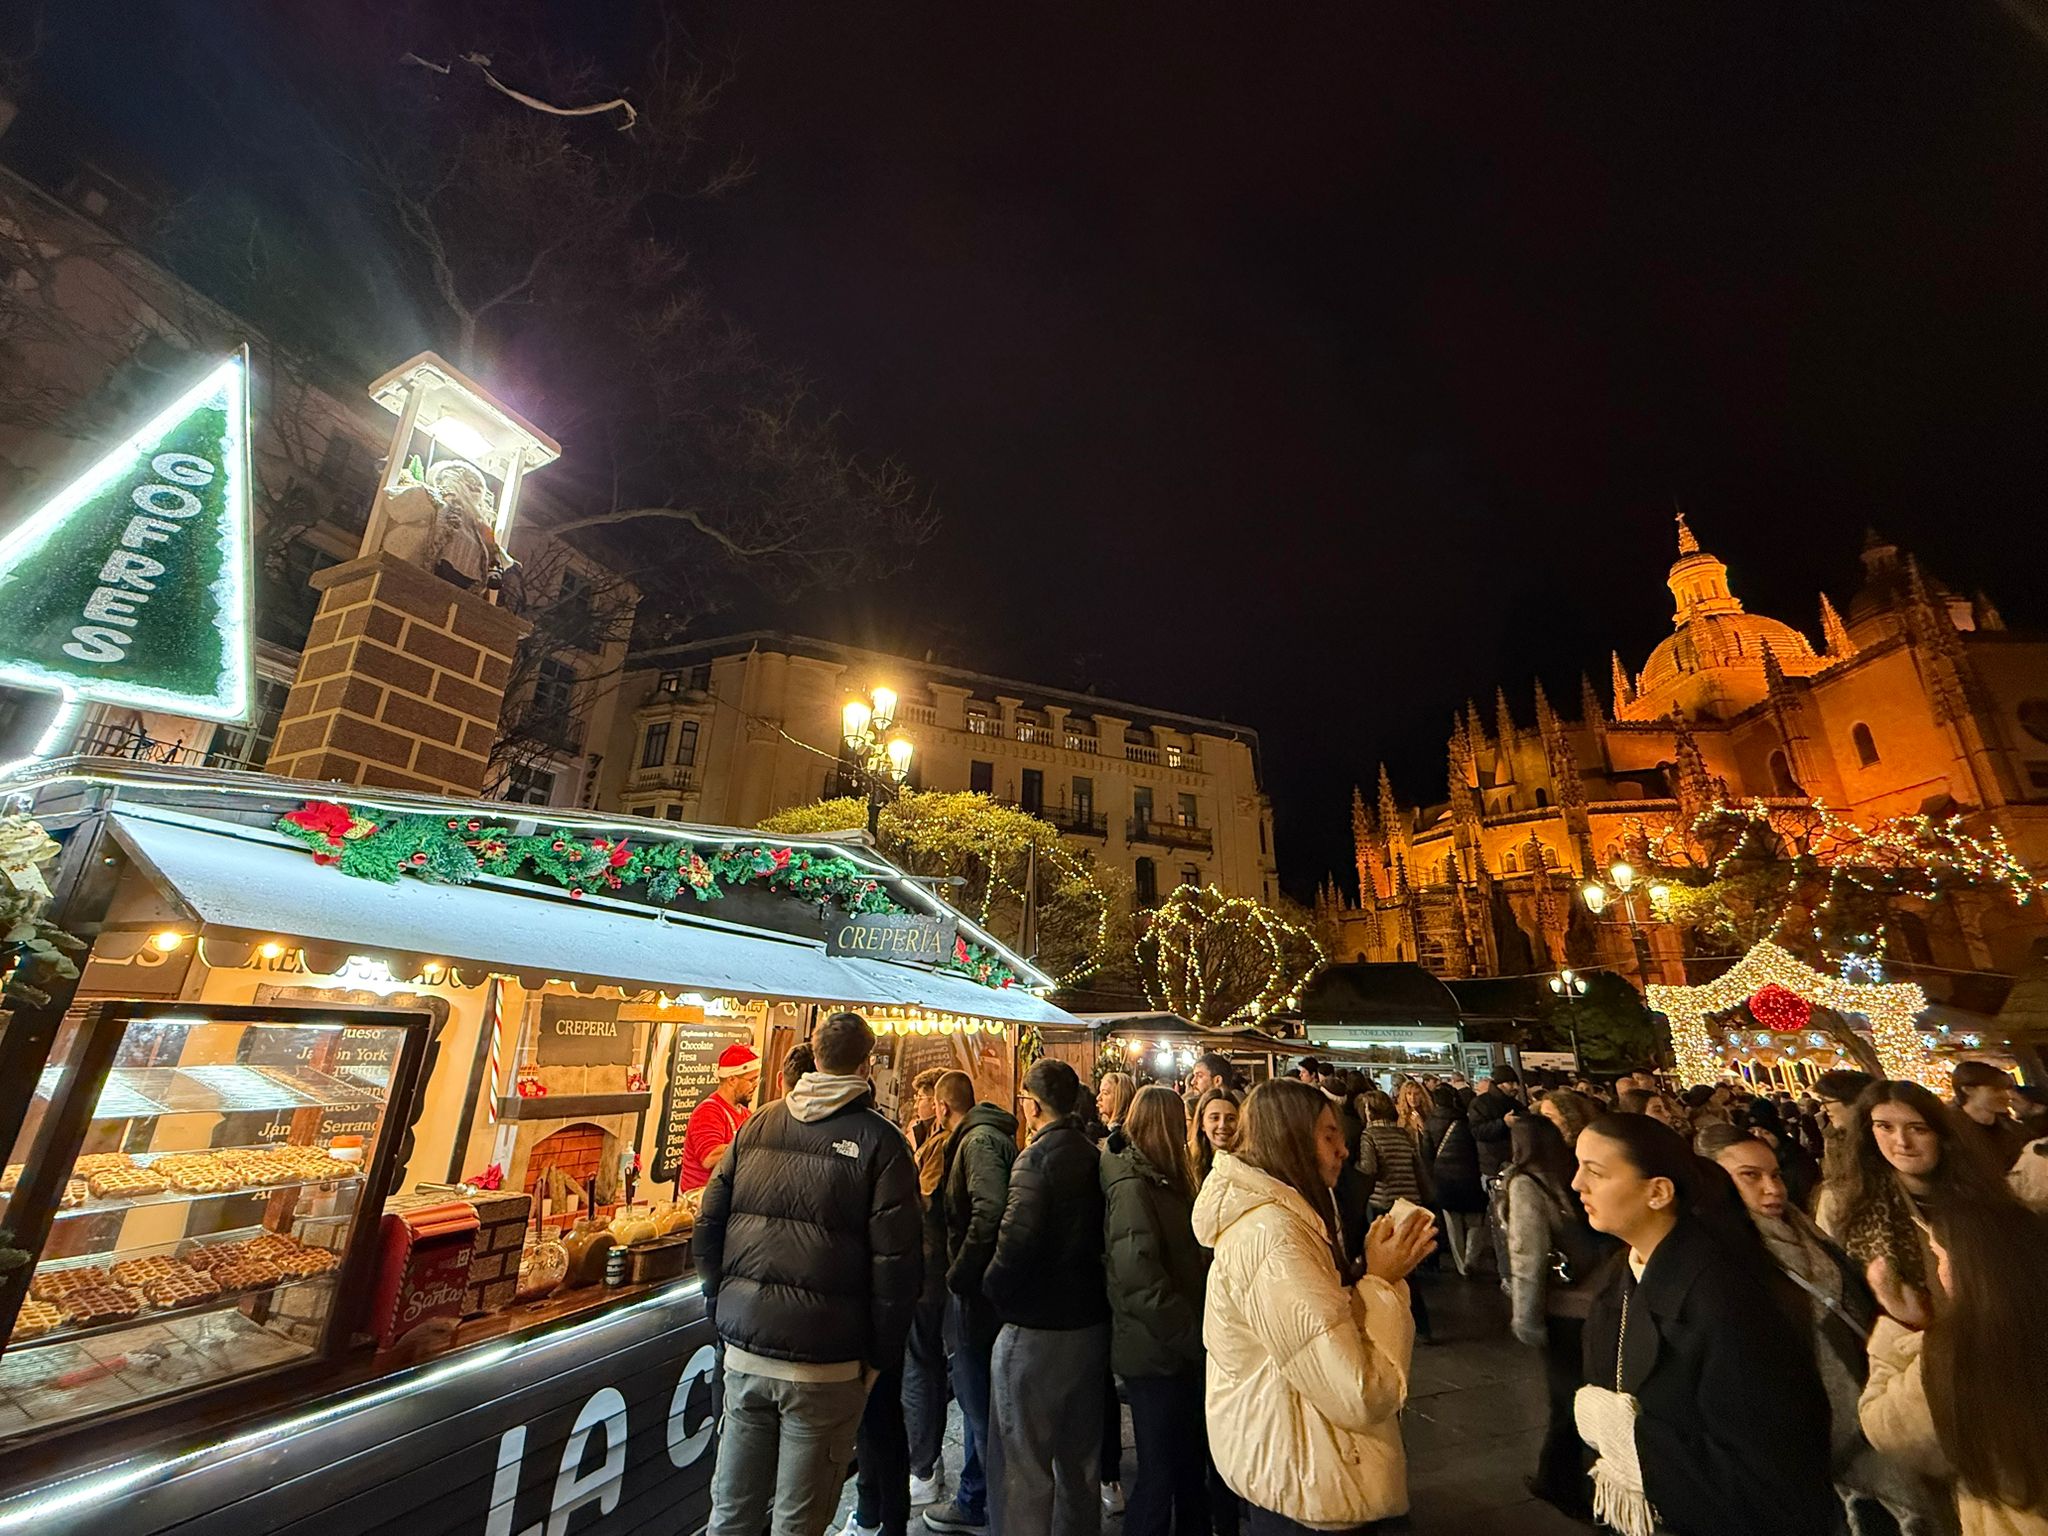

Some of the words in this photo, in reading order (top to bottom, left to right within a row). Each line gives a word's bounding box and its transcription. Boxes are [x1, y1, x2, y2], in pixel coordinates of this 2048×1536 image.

[62, 453, 215, 662] GOFRES
[838, 924, 942, 953] CREPERÍA
[555, 1019, 618, 1037] CREPERIA
[356, 1047, 388, 1061] York
[680, 1041, 714, 1050] Chocolate
[678, 1052, 697, 1061] Fresa
[677, 1063, 711, 1074] Chocolate
[403, 1283, 463, 1322] Santa
[484, 1386, 627, 1536] LA
